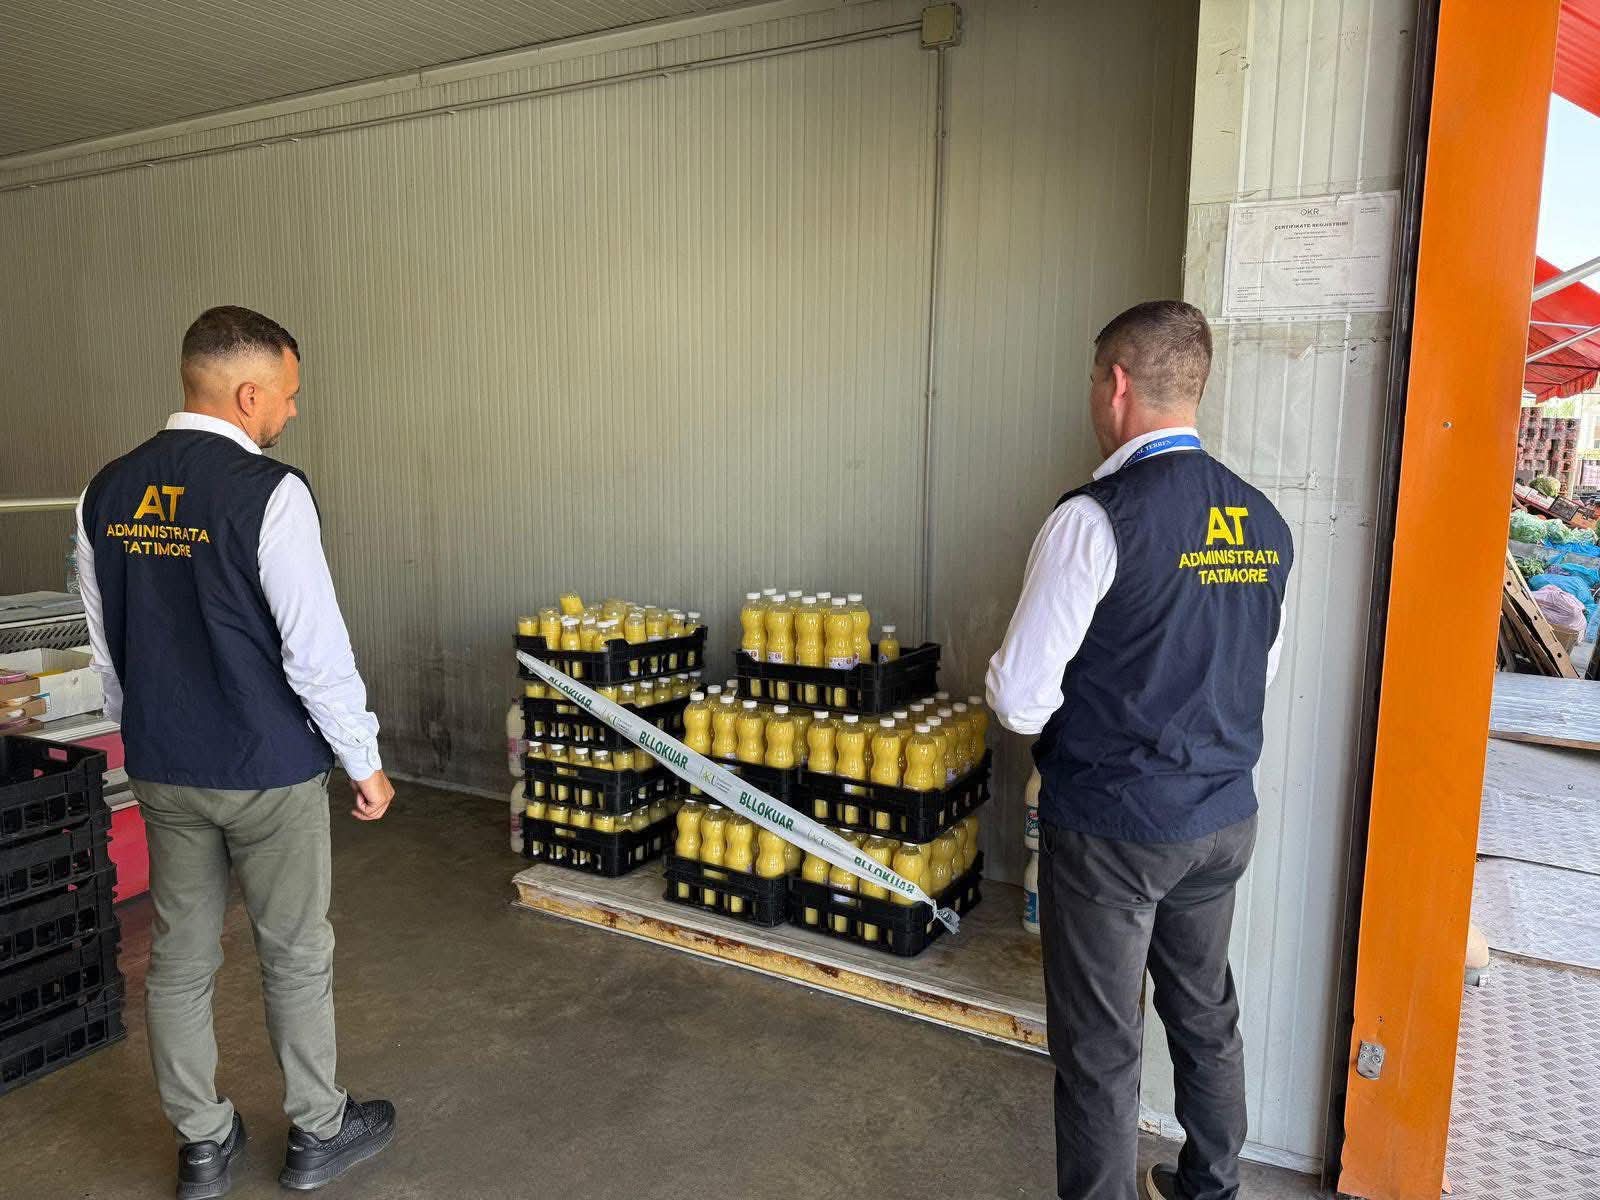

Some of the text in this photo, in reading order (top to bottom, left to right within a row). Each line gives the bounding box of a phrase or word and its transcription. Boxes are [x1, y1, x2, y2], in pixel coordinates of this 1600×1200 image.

[133, 485, 185, 522] AT
[106, 523, 210, 543] ADMINISTRATA
[1205, 506, 1249, 546] AT
[123, 540, 192, 558] TATIMORE
[1178, 550, 1280, 569] ADMINISTRATA
[1198, 568, 1268, 585] TATIMORE
[638, 730, 689, 771] BLLOKUAR
[738, 791, 795, 832] BLLOKUAR
